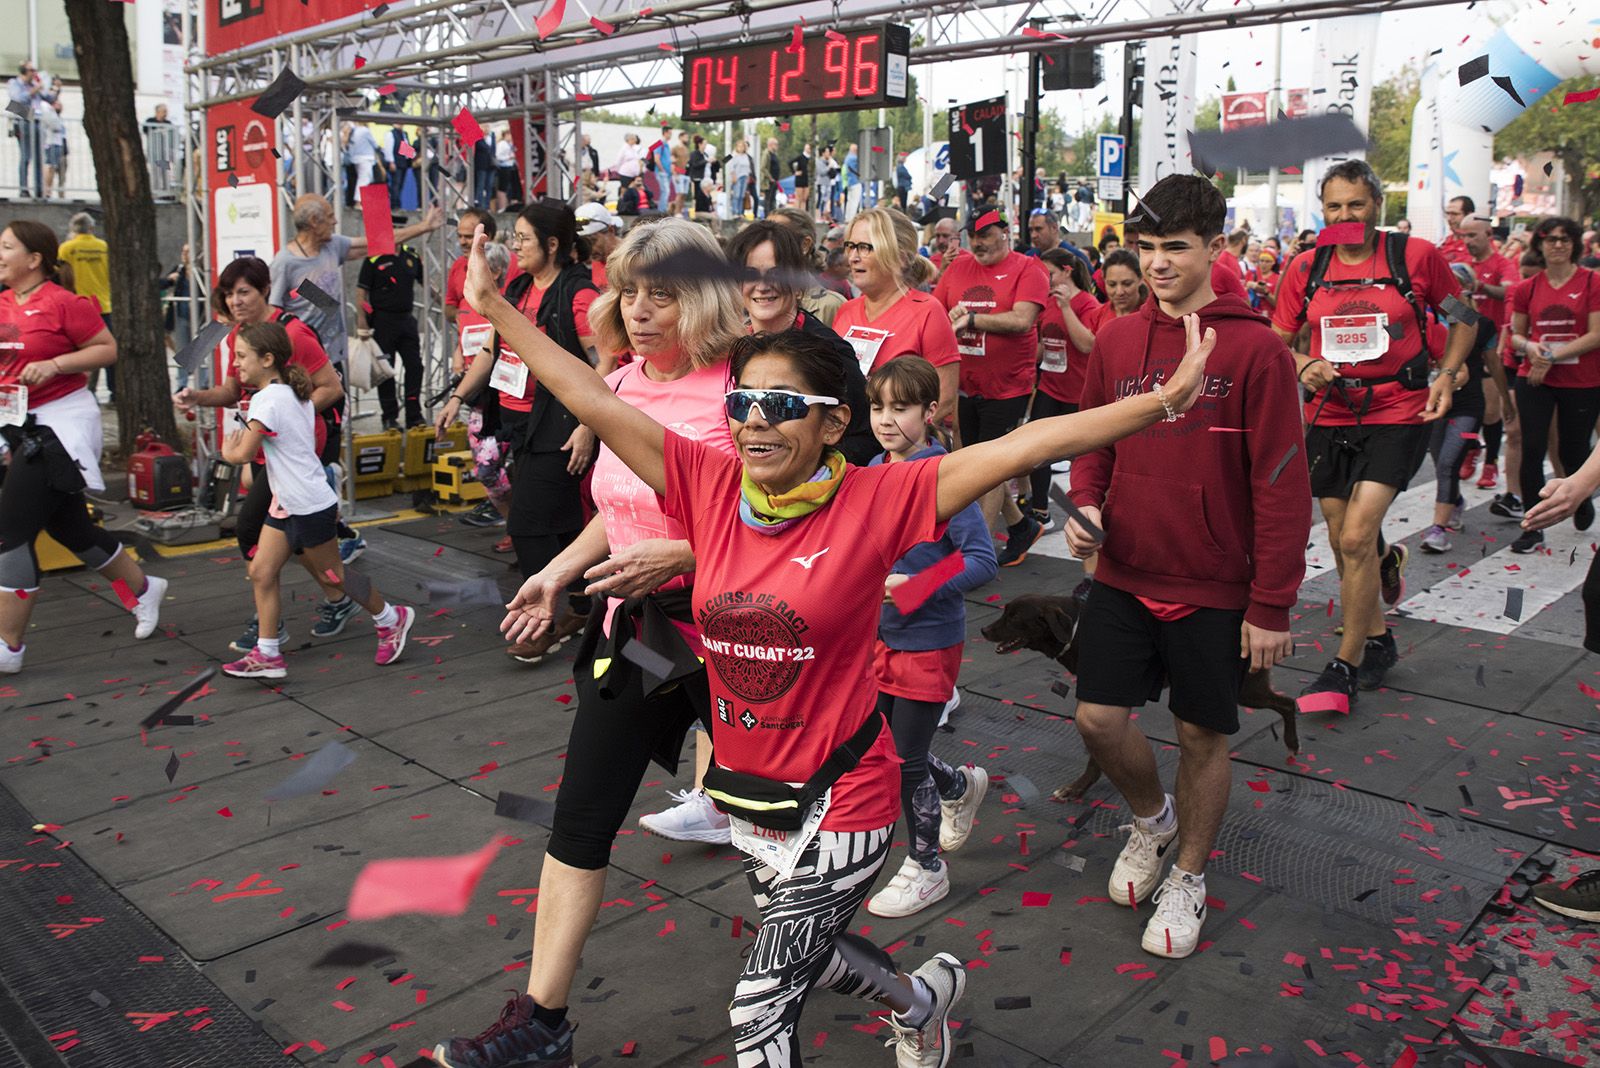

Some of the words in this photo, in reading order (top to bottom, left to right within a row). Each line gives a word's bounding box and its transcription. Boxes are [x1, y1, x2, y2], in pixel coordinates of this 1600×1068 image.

[690, 56, 738, 111] 04
[767, 46, 806, 102] 12
[824, 35, 879, 98] 96
[969, 127, 983, 172] 1
[1103, 139, 1120, 174] P
[1336, 333, 1367, 343] 3295
[705, 591, 753, 612] CURSA
[755, 593, 776, 607] DE
[775, 600, 809, 635] RAC1
[733, 643, 786, 662] CUGAT
[752, 824, 787, 842] 1740
